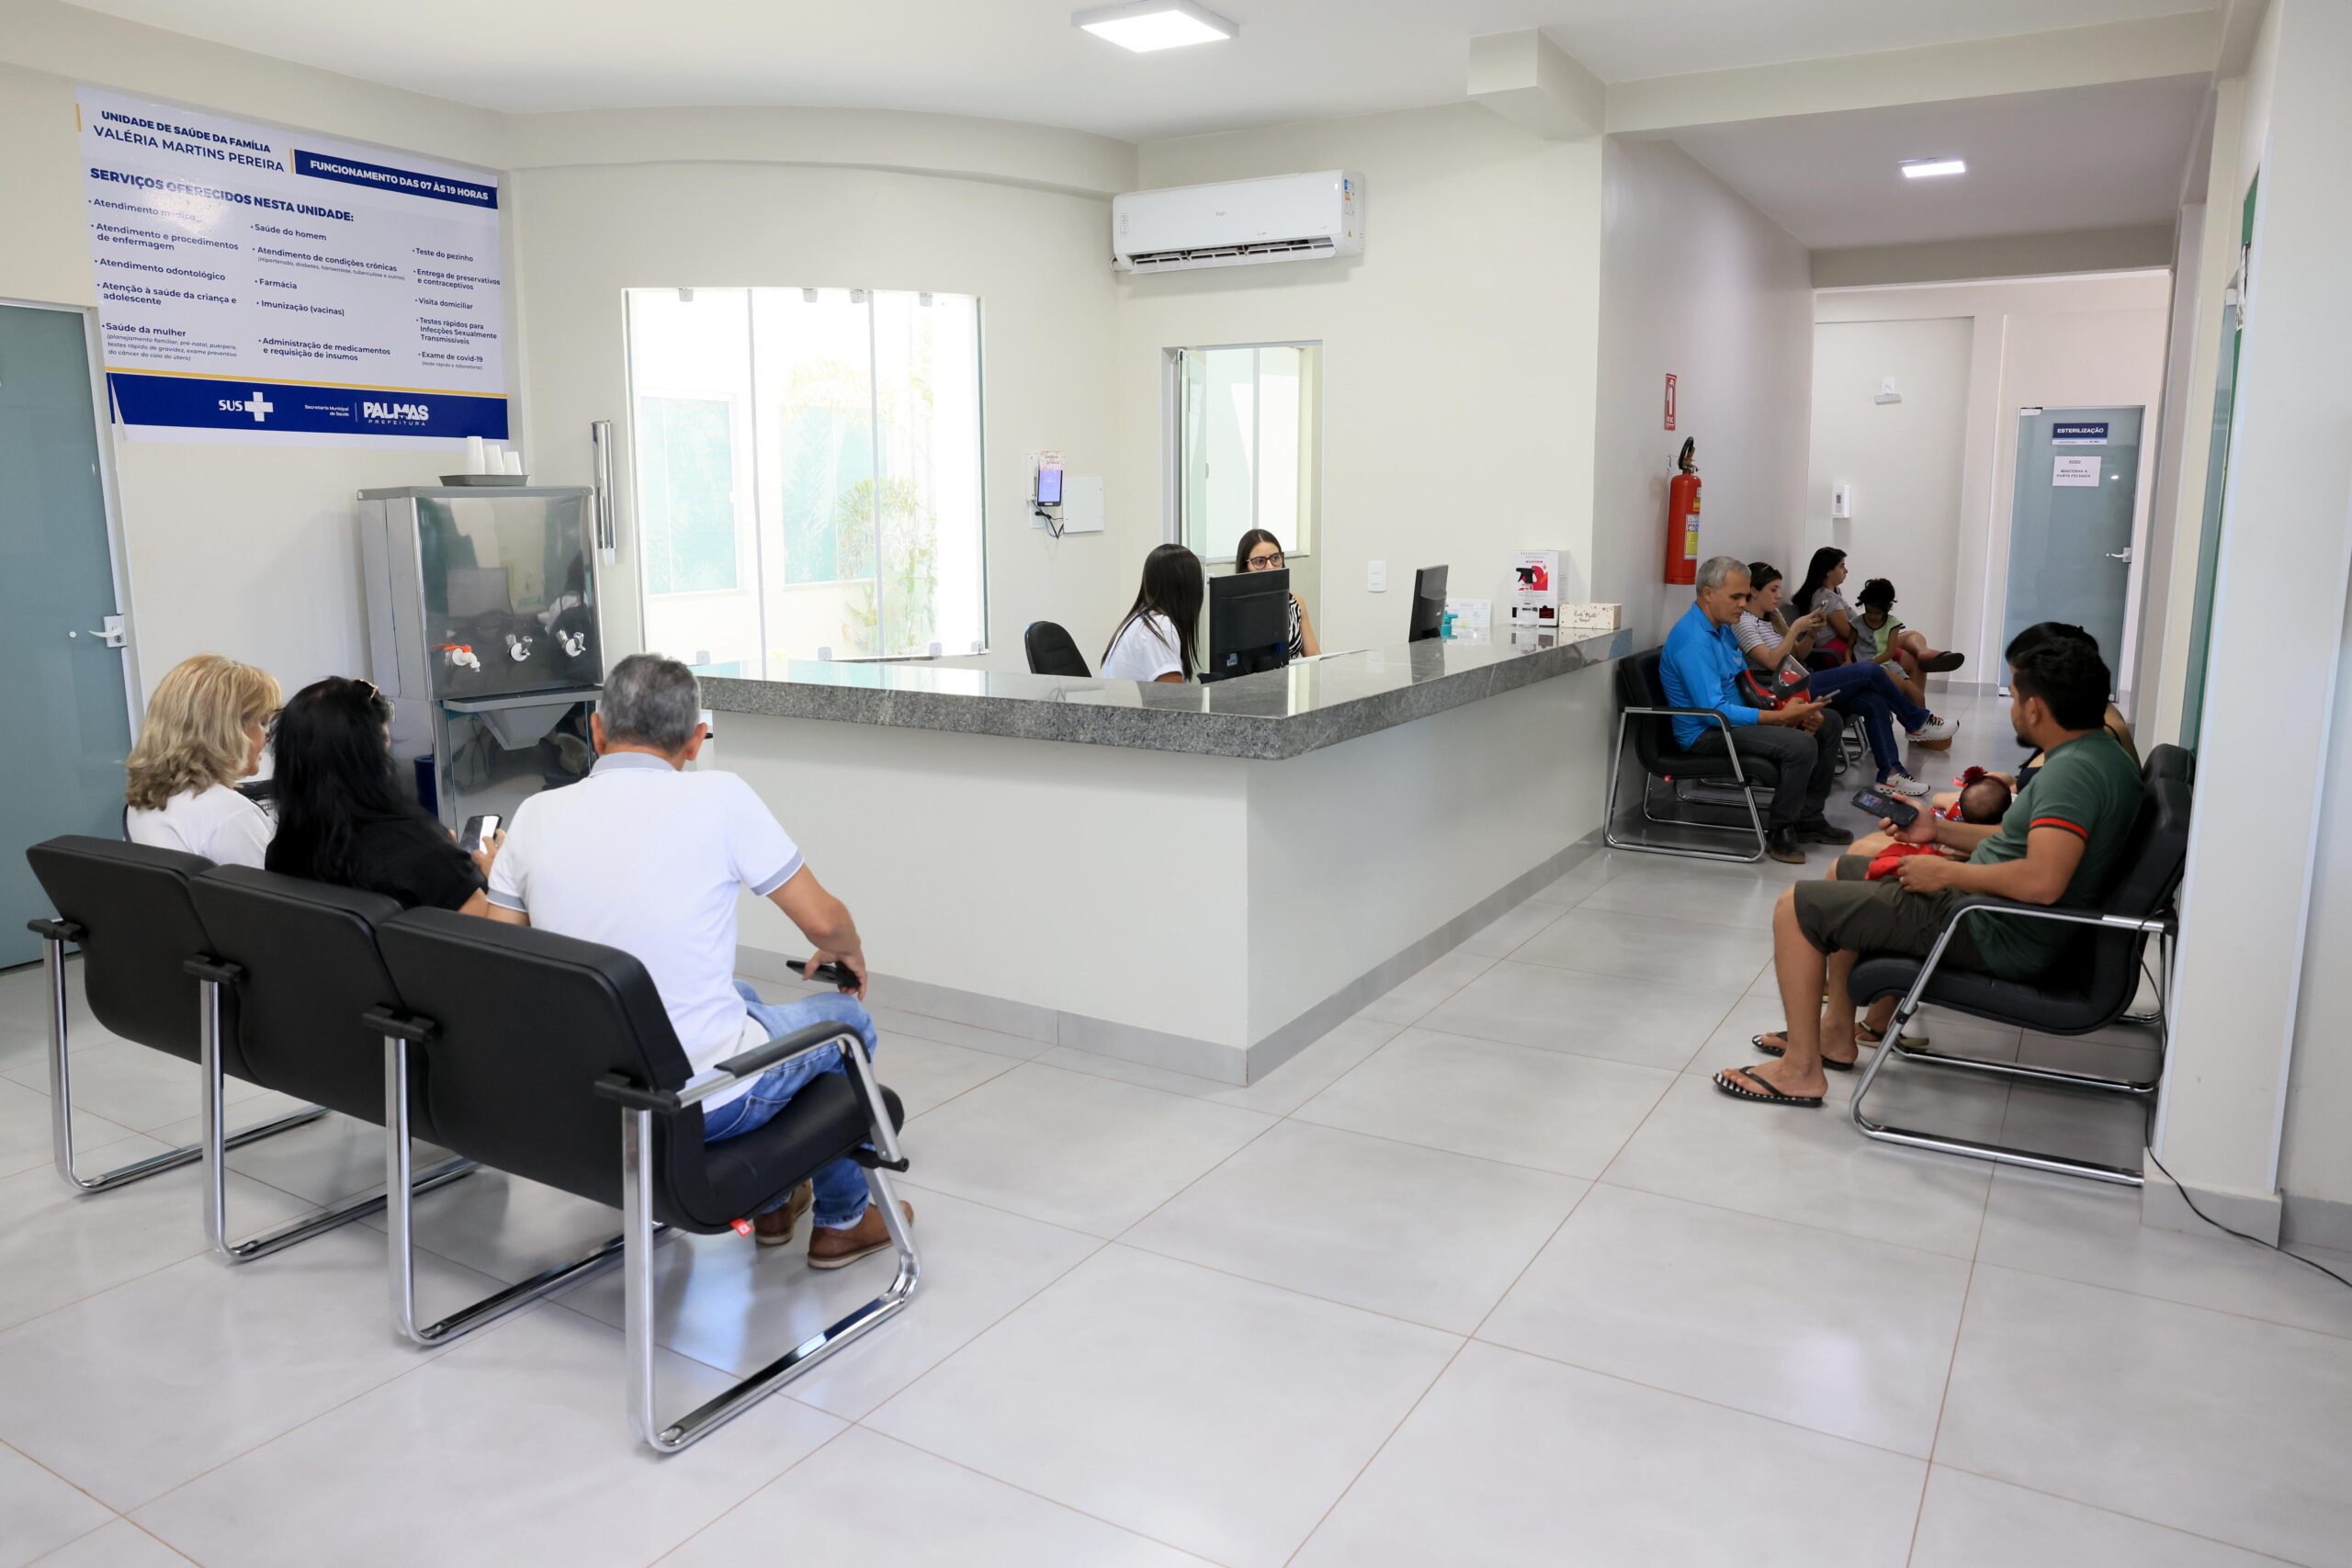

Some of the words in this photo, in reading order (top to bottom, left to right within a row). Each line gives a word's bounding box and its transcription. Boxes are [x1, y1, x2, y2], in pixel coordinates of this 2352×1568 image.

[101, 110, 154, 129] UNIDADE
[156, 122, 172, 132] DE
[174, 127, 210, 141] SAÚDE
[212, 133, 228, 144] DA
[230, 137, 271, 152] FAMÍLIA
[93, 125, 159, 148] VALÉRIA
[163, 140, 224, 160] MARTINS
[229, 152, 284, 172] PEREIRA
[310, 160, 398, 184] FUNCIONAMENTO
[400, 177, 419, 188] DAS
[420, 181, 432, 190] 07
[433, 182, 446, 193] ÀS
[447, 186, 456, 194] 19
[457, 187, 489, 200] HORAS
[90, 167, 164, 190] SERVIÇOS
[166, 182, 252, 205] OFERECIDOS
[254, 197, 295, 212] NESTA
[297, 204, 354, 221] UNIDADE:
[94, 198, 158, 215] Atendimento
[96, 222, 161, 239] Atendimento
[171, 234, 239, 250] procedimentos
[254, 223, 280, 234] Saúde
[283, 228, 293, 236] do
[295, 231, 327, 241] homem
[112, 236, 175, 251] enfermagem
[257, 246, 311, 261] Atendimento
[313, 254, 323, 262] de
[325, 255, 364, 267] condições
[366, 262, 398, 272] crônicas
[415, 247, 435, 256] Teste
[447, 253, 473, 262] pezinho
[100, 258, 164, 273] Atendimento
[166, 266, 226, 280] odontológico
[417, 268, 444, 278] Entrega
[457, 275, 501, 286] preservativos
[259, 278, 298, 289] Farmácia
[424, 278, 474, 289] contraceptivos
[102, 282, 142, 294] Atenção
[153, 288, 181, 298] saúde
[184, 291, 195, 299] da
[197, 293, 230, 304] criança
[103, 292, 162, 305] adolescente
[261, 299, 309, 311] Imunização
[310, 305, 345, 317] (vacinas)
[418, 298, 438, 306] Visita
[440, 300, 473, 310] domiciliar
[420, 317, 441, 325] Testes
[106, 323, 136, 333] Saúde
[153, 328, 187, 337] mulher
[107, 333, 153, 343] (planejamento
[420, 326, 453, 335] Infecções
[455, 329, 497, 339] Sexualmente
[128, 344, 148, 352] rápido
[263, 338, 322, 350] Administração
[334, 344, 391, 355] medicamentos
[271, 348, 312, 358] requisição
[325, 352, 358, 361] insumos
[218, 400, 243, 412] SUS
[363, 401, 429, 421] PALMAS
